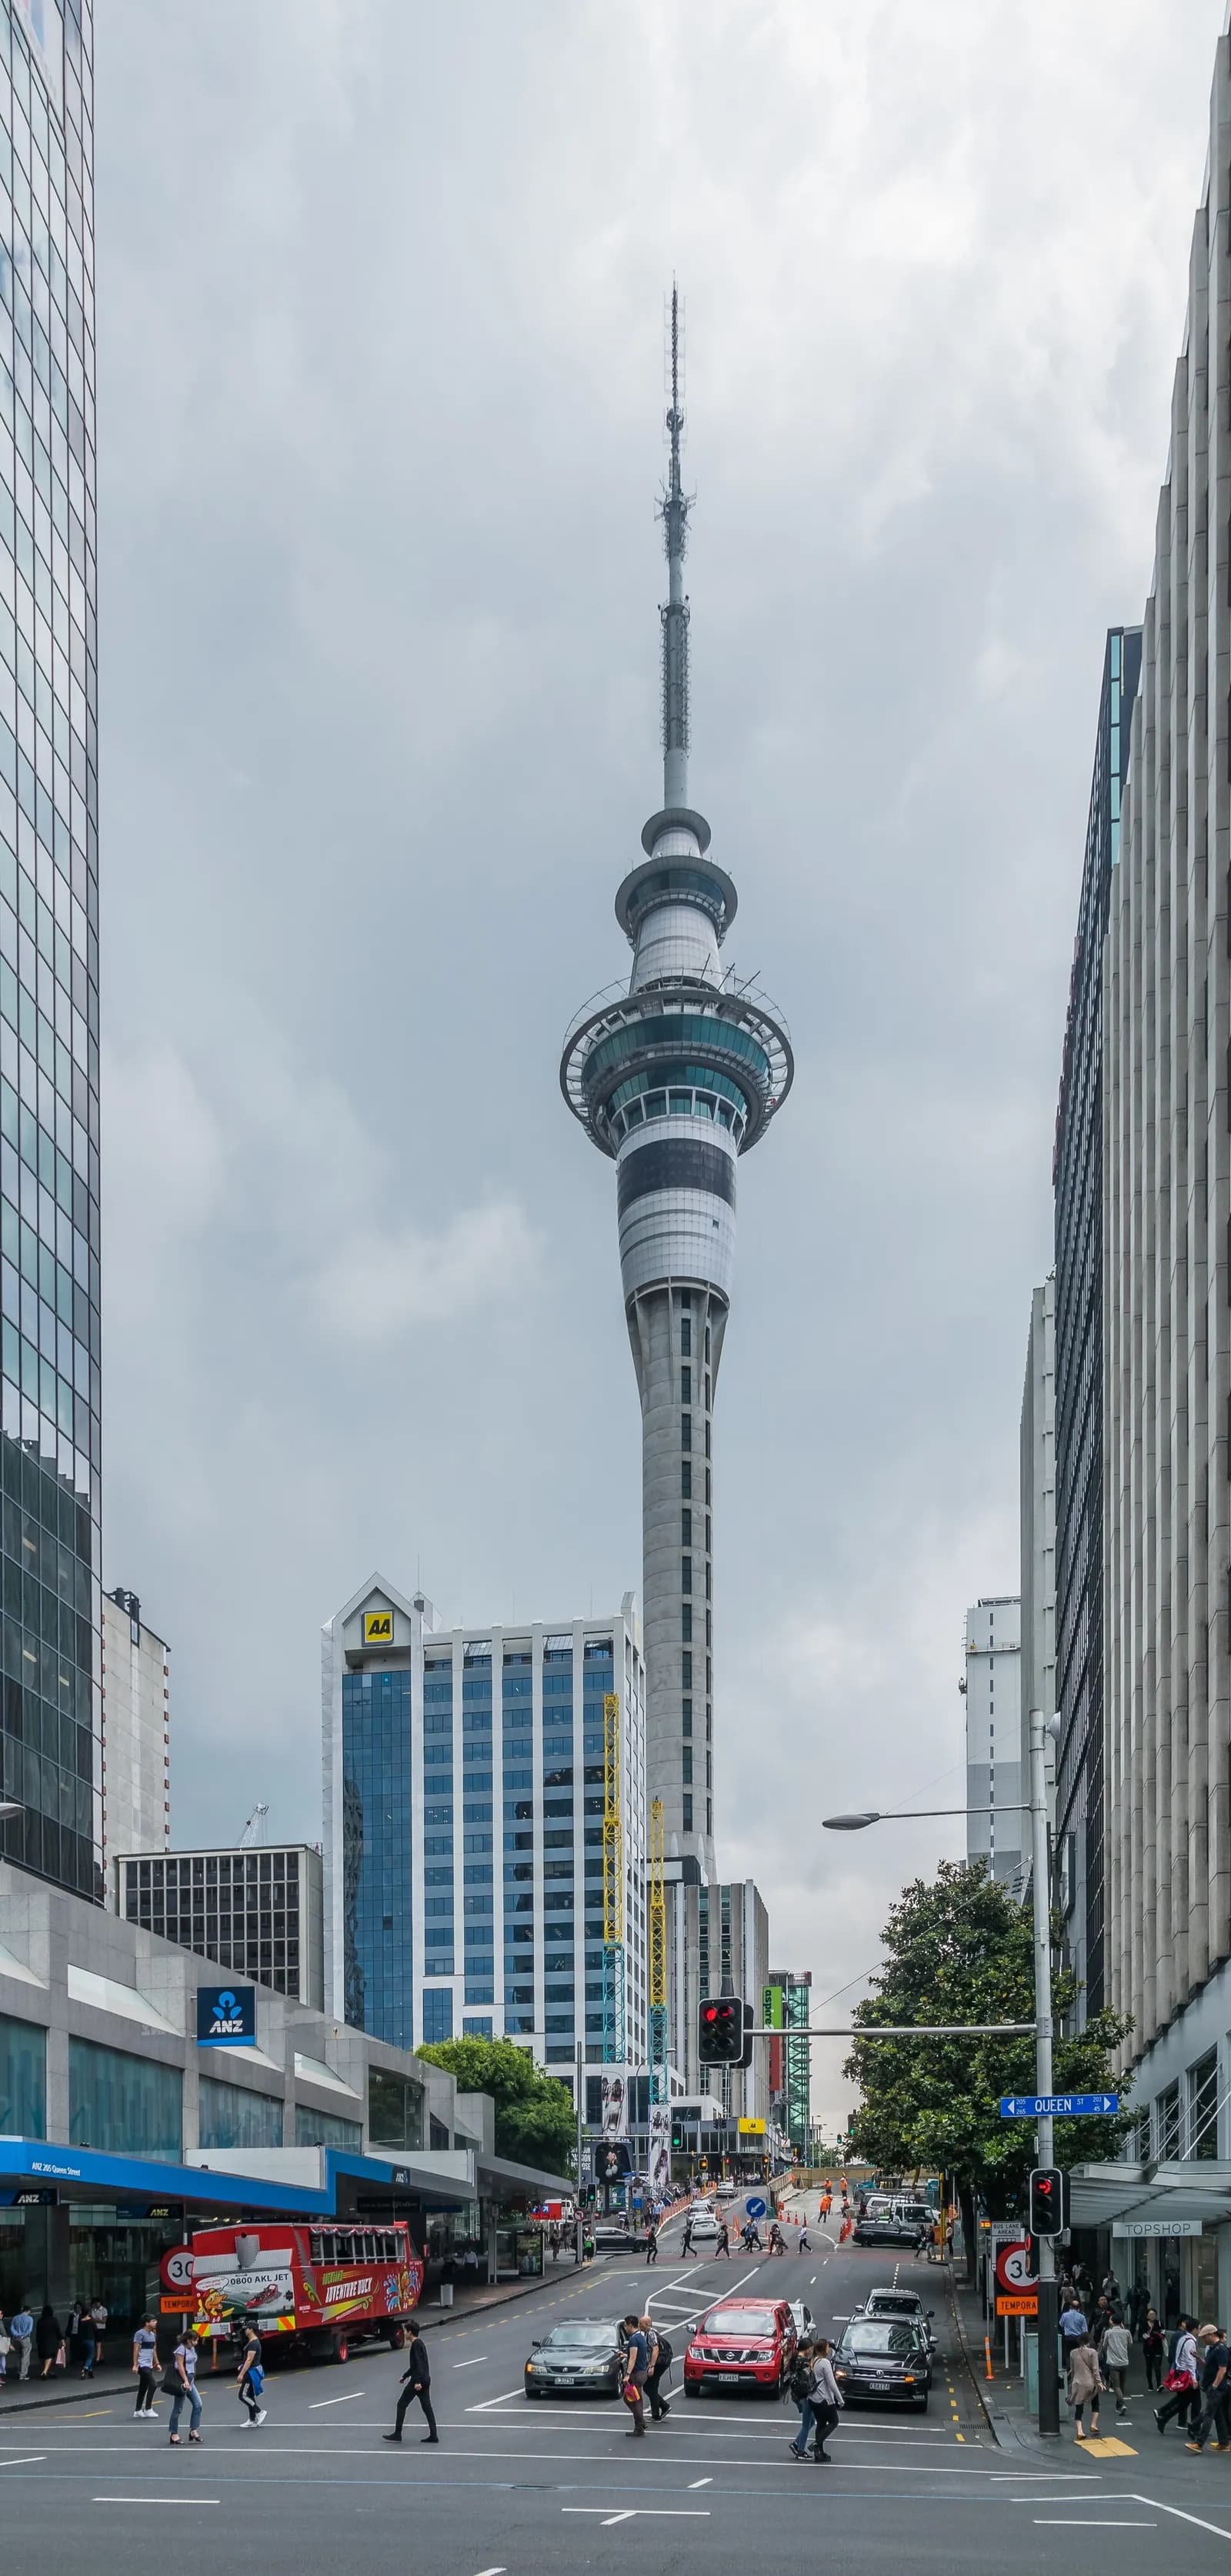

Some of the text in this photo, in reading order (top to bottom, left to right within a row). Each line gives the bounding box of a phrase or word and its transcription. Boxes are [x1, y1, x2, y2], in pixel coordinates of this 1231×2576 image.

[369, 1618, 390, 1635] AA
[209, 2020, 243, 2033] ANZ
[1035, 2099, 1072, 2112] QUEEN
[32, 2162, 80, 2176] ANZ 205 Queen Street
[17, 2194, 39, 2203] ANZ
[1125, 2223, 1190, 2234] TOPSHOP
[274, 2273, 289, 2282] JET
